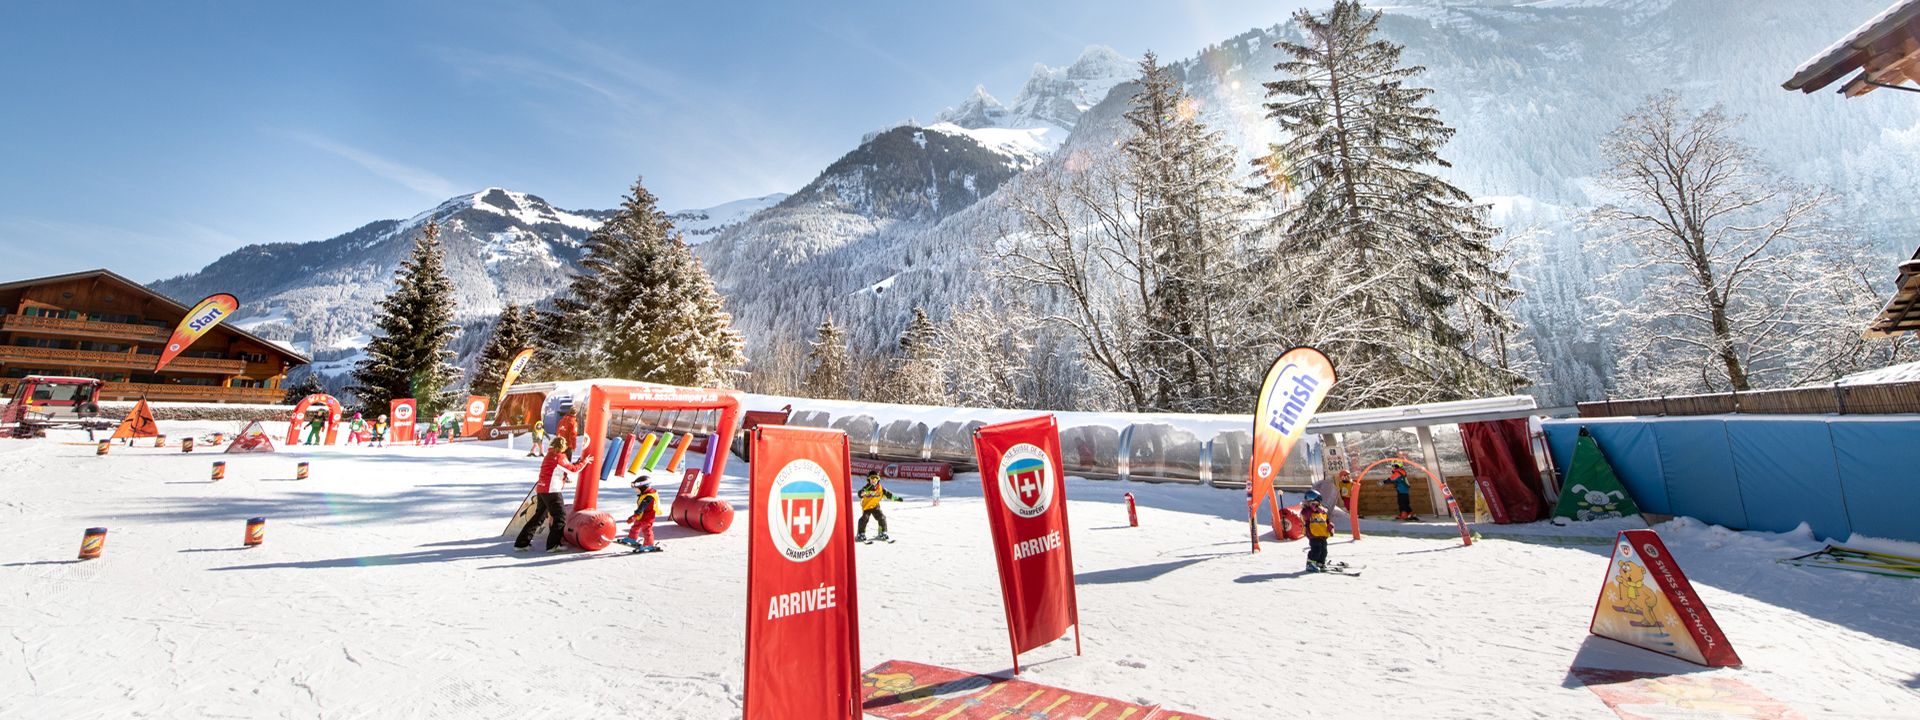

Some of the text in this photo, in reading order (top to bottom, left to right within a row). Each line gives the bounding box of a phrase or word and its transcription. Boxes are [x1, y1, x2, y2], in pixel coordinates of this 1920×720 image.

[189, 307, 223, 332] Start
[629, 392, 718, 403] www.esschampery.ch
[1269, 374, 1319, 436] Finish
[1002, 451, 1014, 467] ECOLE
[1012, 444, 1029, 454] SUISSE
[1038, 451, 1046, 460] SKI
[776, 461, 830, 487] ECOLE SUISSE DE SKI
[1019, 505, 1045, 516] CHAMPÉRY
[785, 547, 816, 559] CHAMPÉRY
[1013, 529, 1061, 561] ARRIVÉE
[767, 582, 836, 620] ARRIVÉE
[1655, 560, 1716, 649] SWISS SKI SCHOOL
